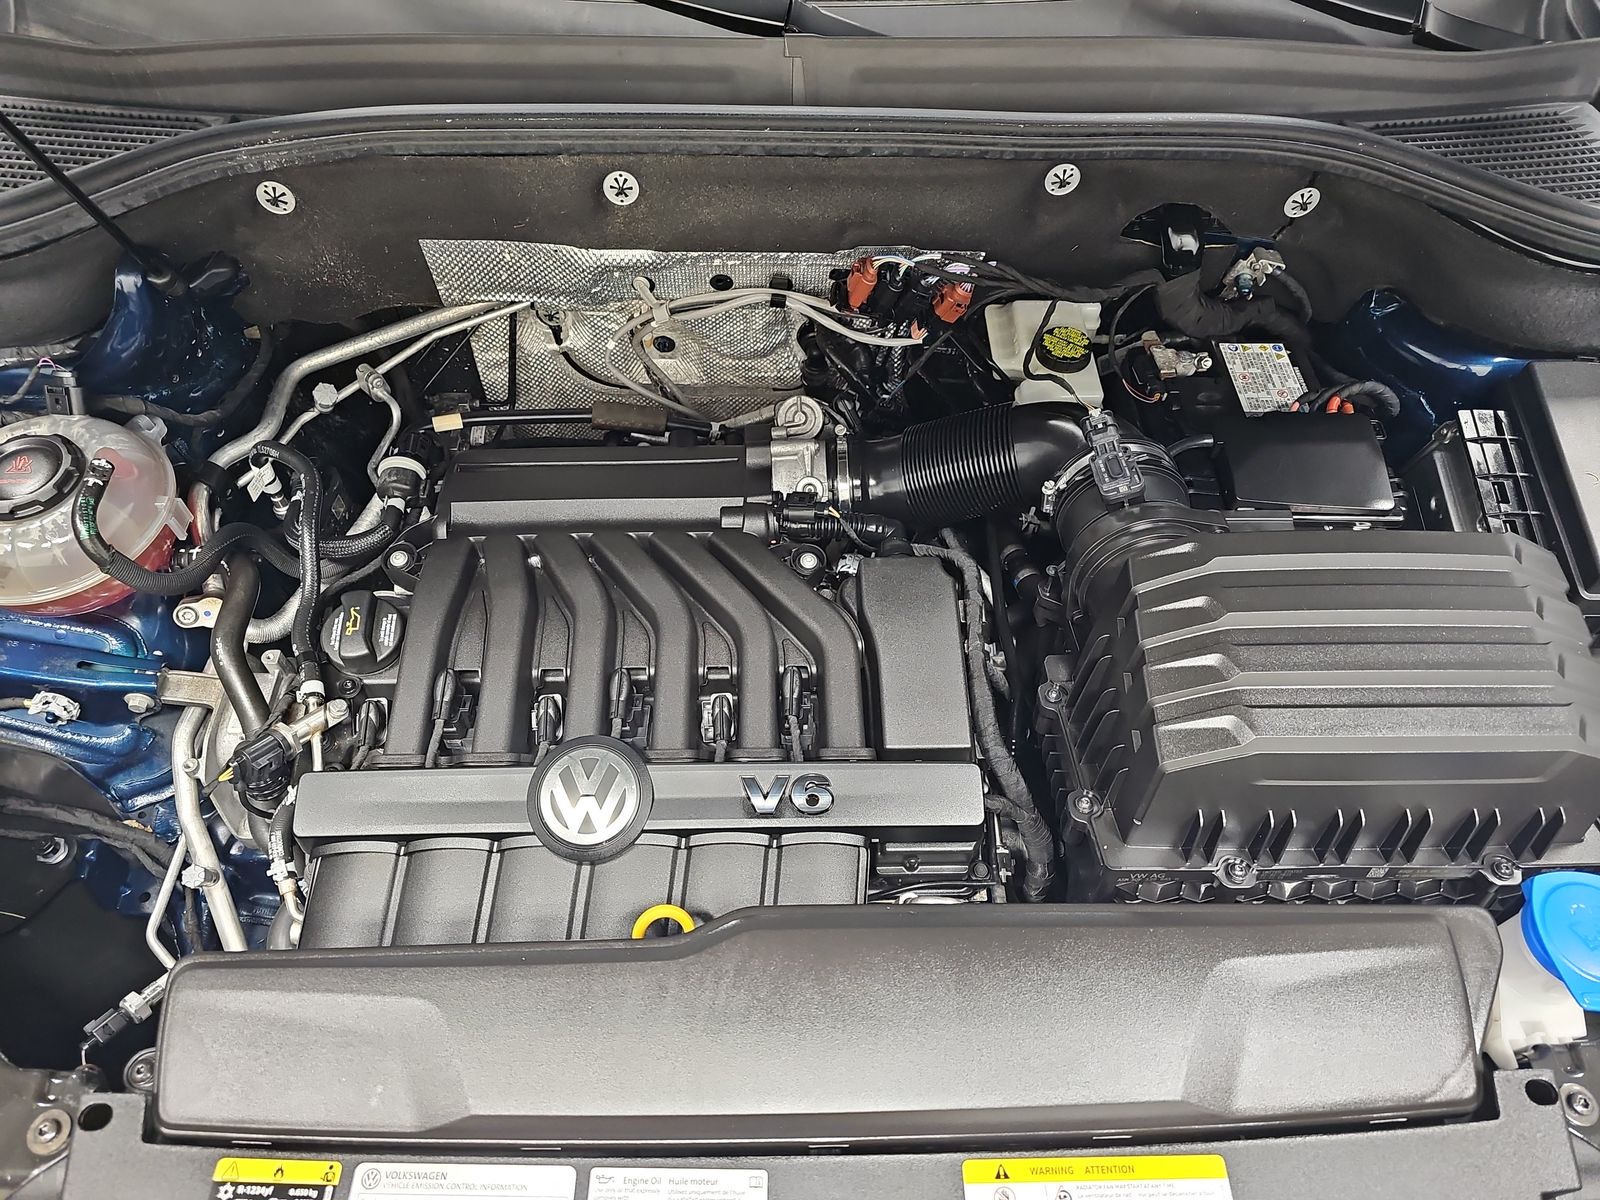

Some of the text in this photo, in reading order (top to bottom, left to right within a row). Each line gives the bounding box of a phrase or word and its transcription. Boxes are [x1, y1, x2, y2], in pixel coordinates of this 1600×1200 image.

[739, 773, 835, 816] V6
[1030, 1165, 1136, 1175] WARNING ATTENTION
[385, 1171, 448, 1180] VOLKSWAGEN
[623, 1176, 662, 1186] Engine Oil
[668, 1178, 719, 1186] Huile moteur
[411, 1182, 444, 1190] EMISSION
